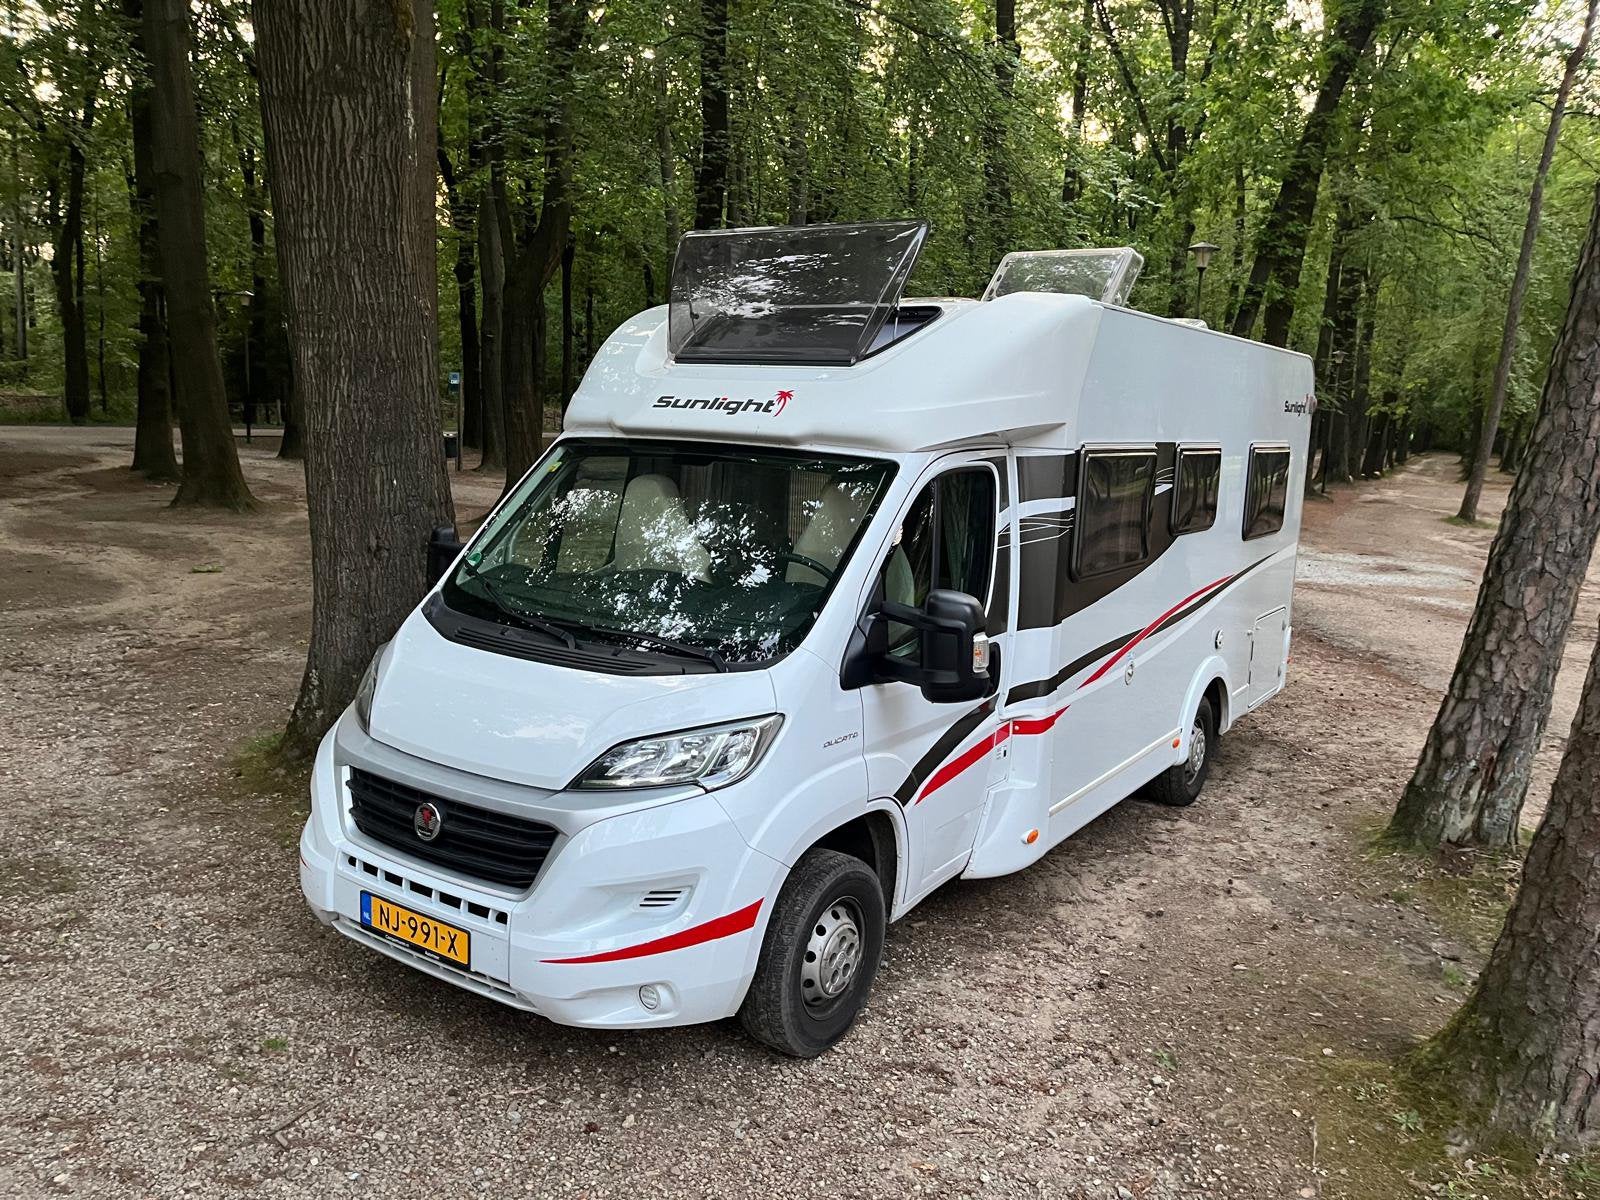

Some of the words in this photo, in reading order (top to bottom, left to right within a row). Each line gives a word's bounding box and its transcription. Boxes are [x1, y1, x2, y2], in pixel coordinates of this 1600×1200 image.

[652, 395, 775, 415] Sunlight
[823, 731, 859, 748] DUCATO
[363, 911, 371, 920] NL
[379, 904, 458, 957] NJ-991-X
